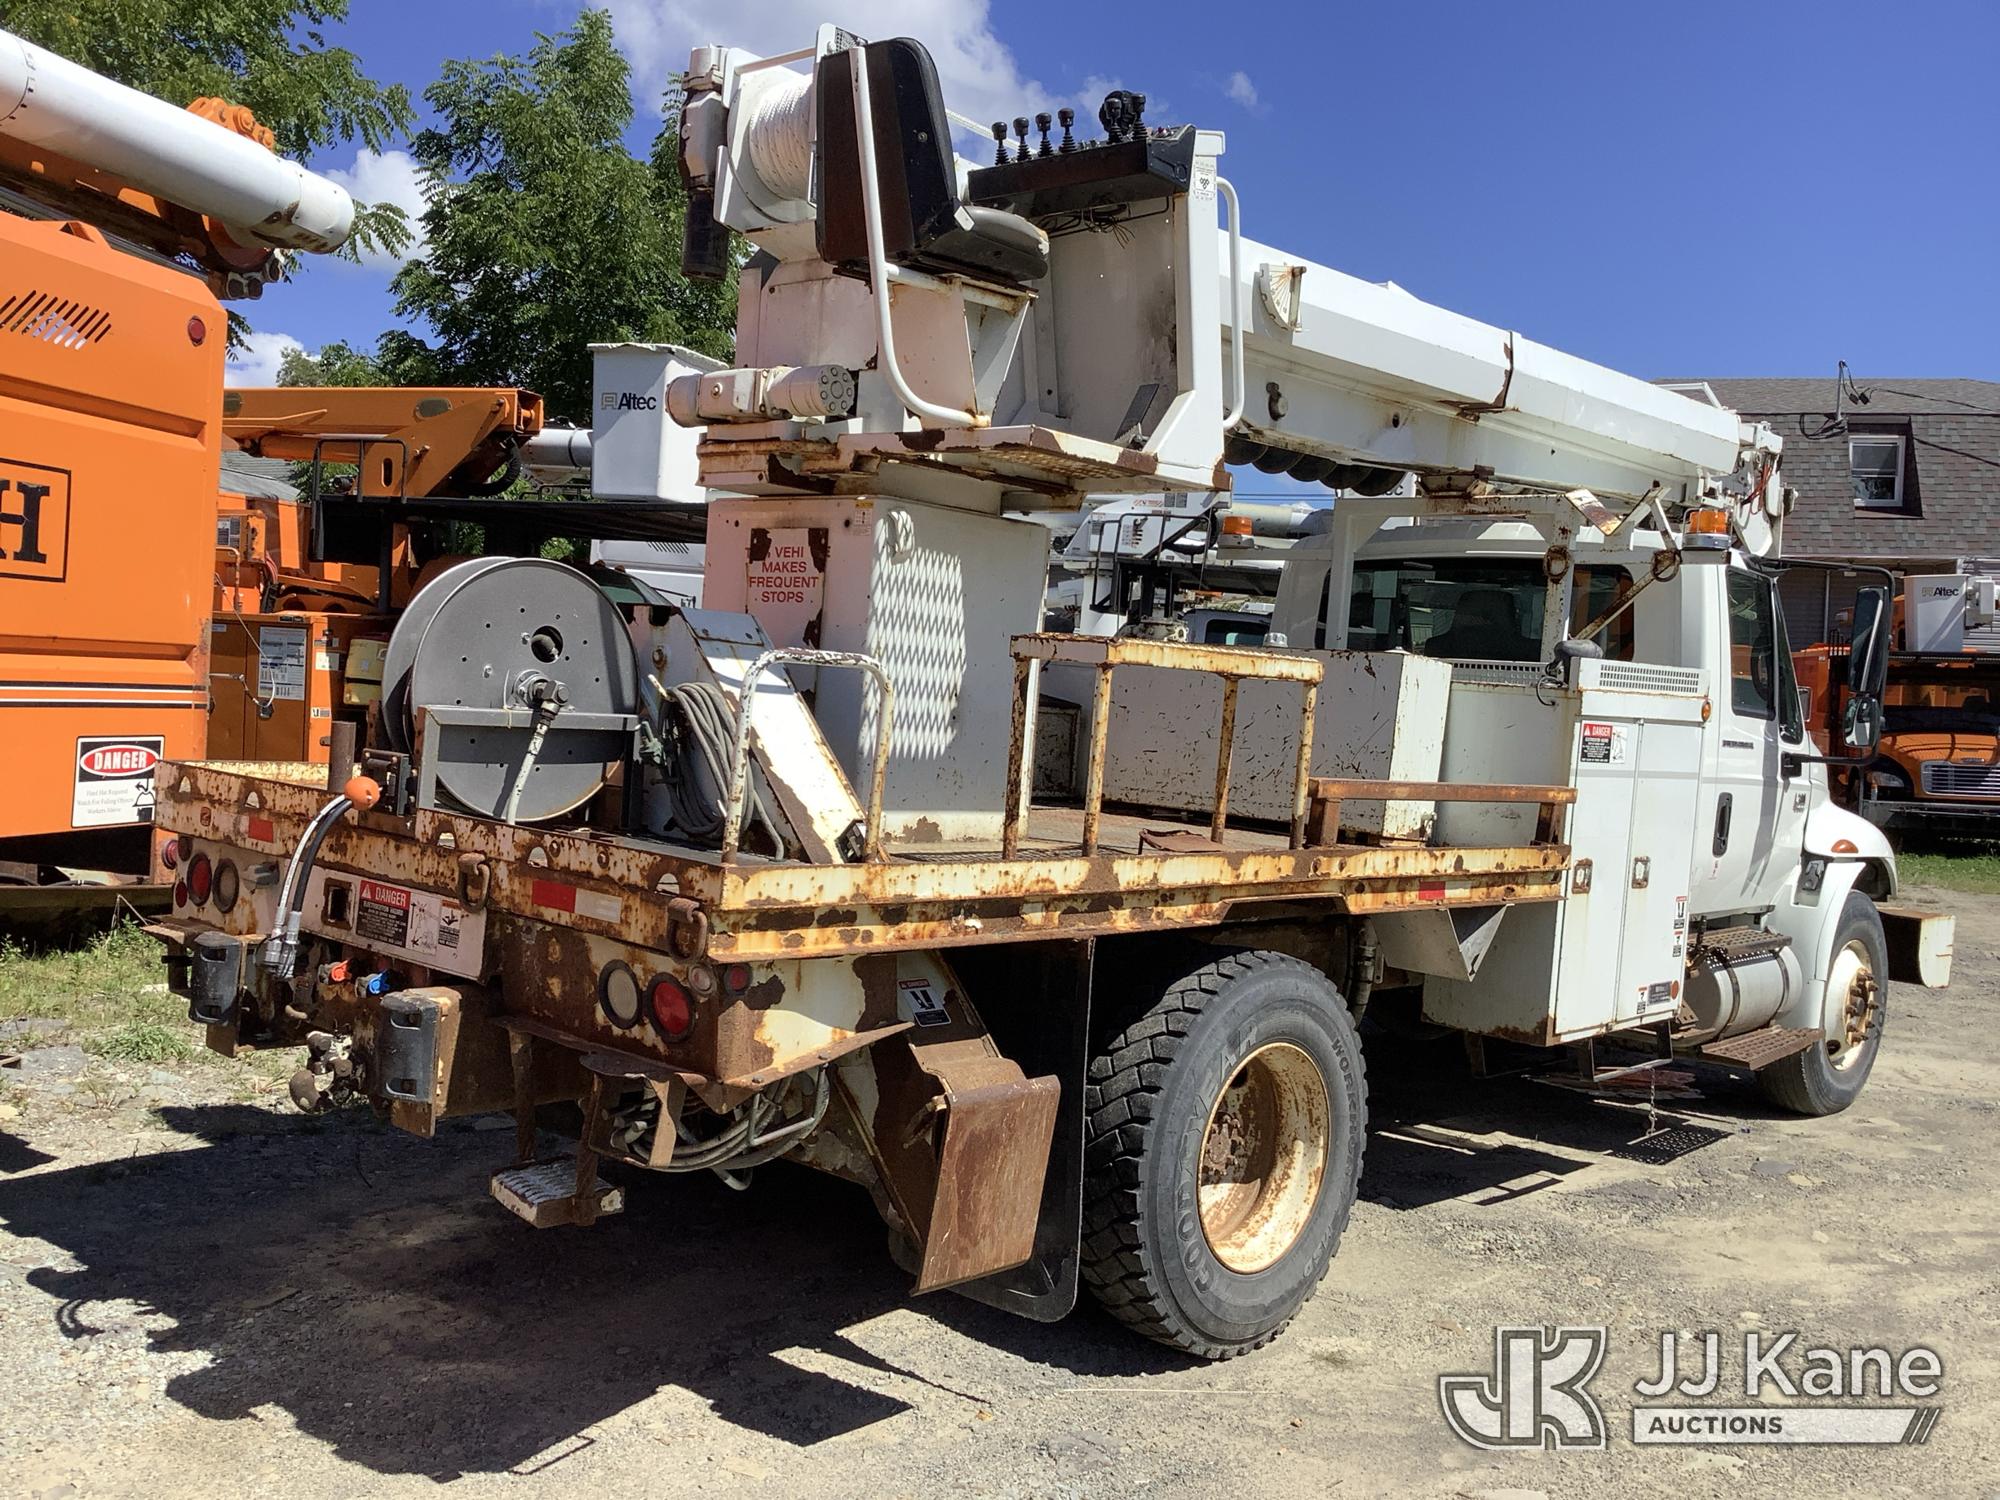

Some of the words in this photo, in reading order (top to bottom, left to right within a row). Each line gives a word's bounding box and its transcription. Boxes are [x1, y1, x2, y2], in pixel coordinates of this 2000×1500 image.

[617, 392, 657, 410] Altec
[761, 561, 807, 573] MAKES
[749, 576, 819, 588] FREQUENT
[761, 591, 804, 603] STOPS
[1933, 586, 1959, 597] Altec
[93, 751, 147, 770] DANGER
[375, 887, 407, 907] DANGER
